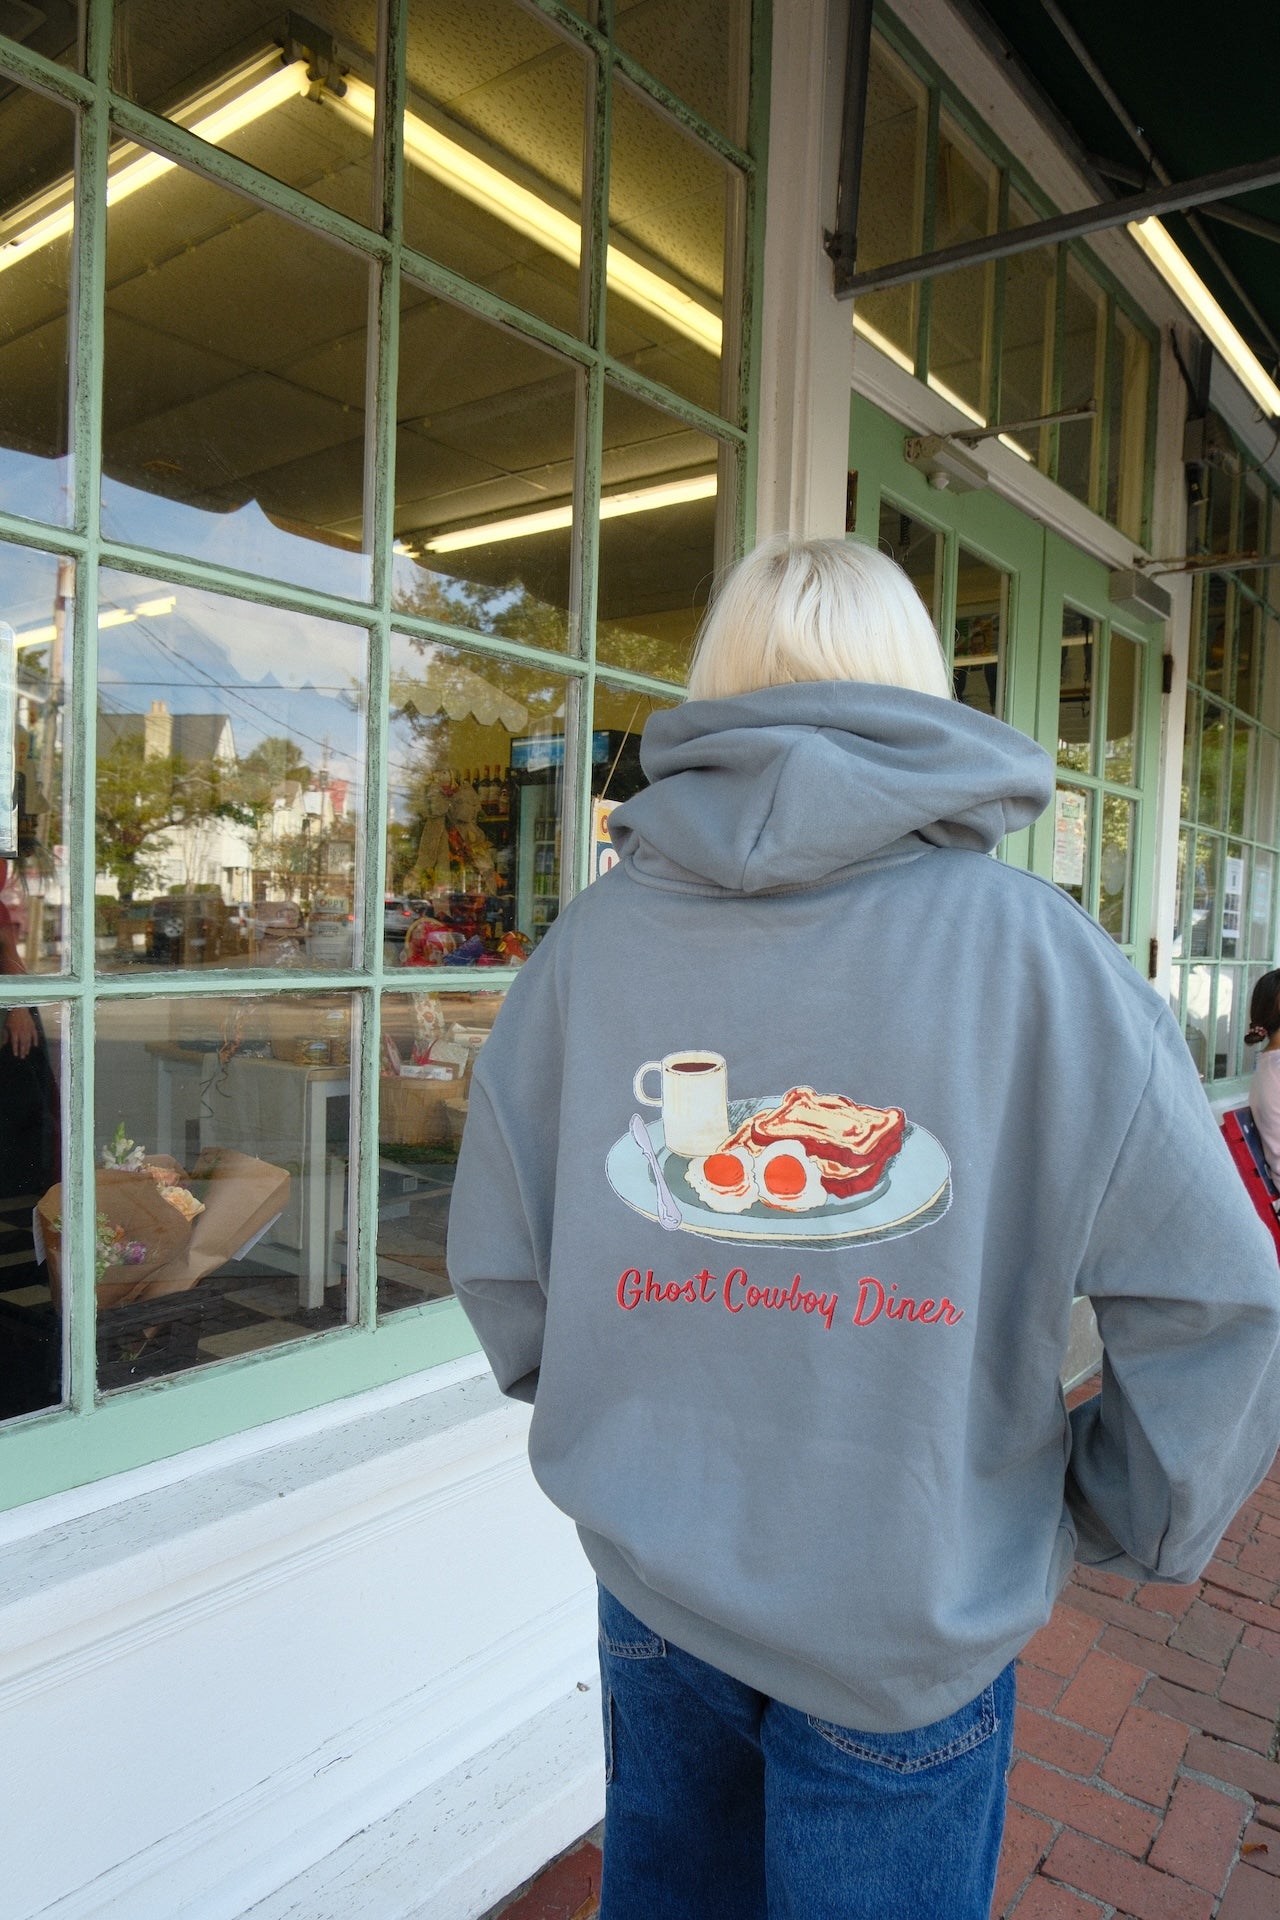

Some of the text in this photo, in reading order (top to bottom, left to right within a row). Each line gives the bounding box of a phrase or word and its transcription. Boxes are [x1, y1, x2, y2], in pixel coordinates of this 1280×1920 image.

[616, 1266, 964, 1331] Ghost Cowboy Diner
